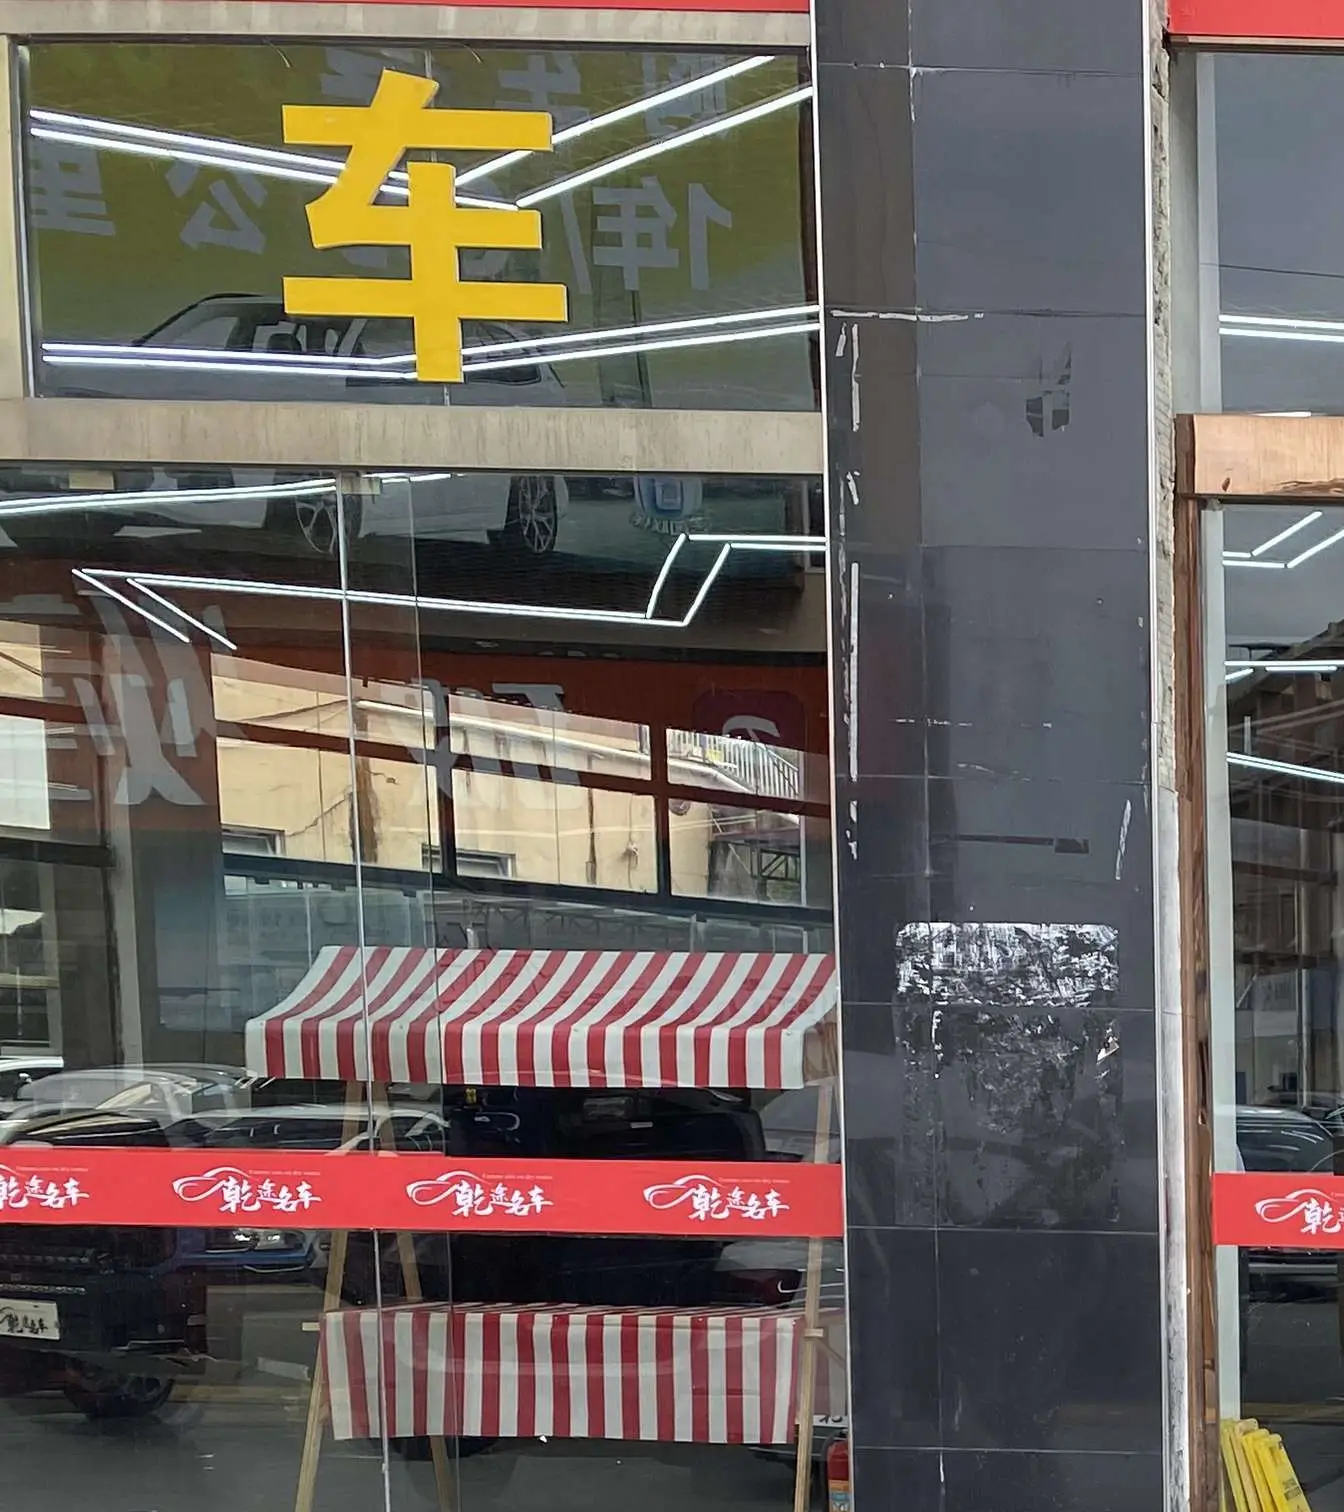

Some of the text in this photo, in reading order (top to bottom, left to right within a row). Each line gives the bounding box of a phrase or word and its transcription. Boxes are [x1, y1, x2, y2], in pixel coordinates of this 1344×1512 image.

[281, 68, 568, 384] 车
[220, 1176, 323, 1214] 乾途名车
[452, 1178, 555, 1217] 乾途名车
[688, 1182, 791, 1222] 乾途名车
